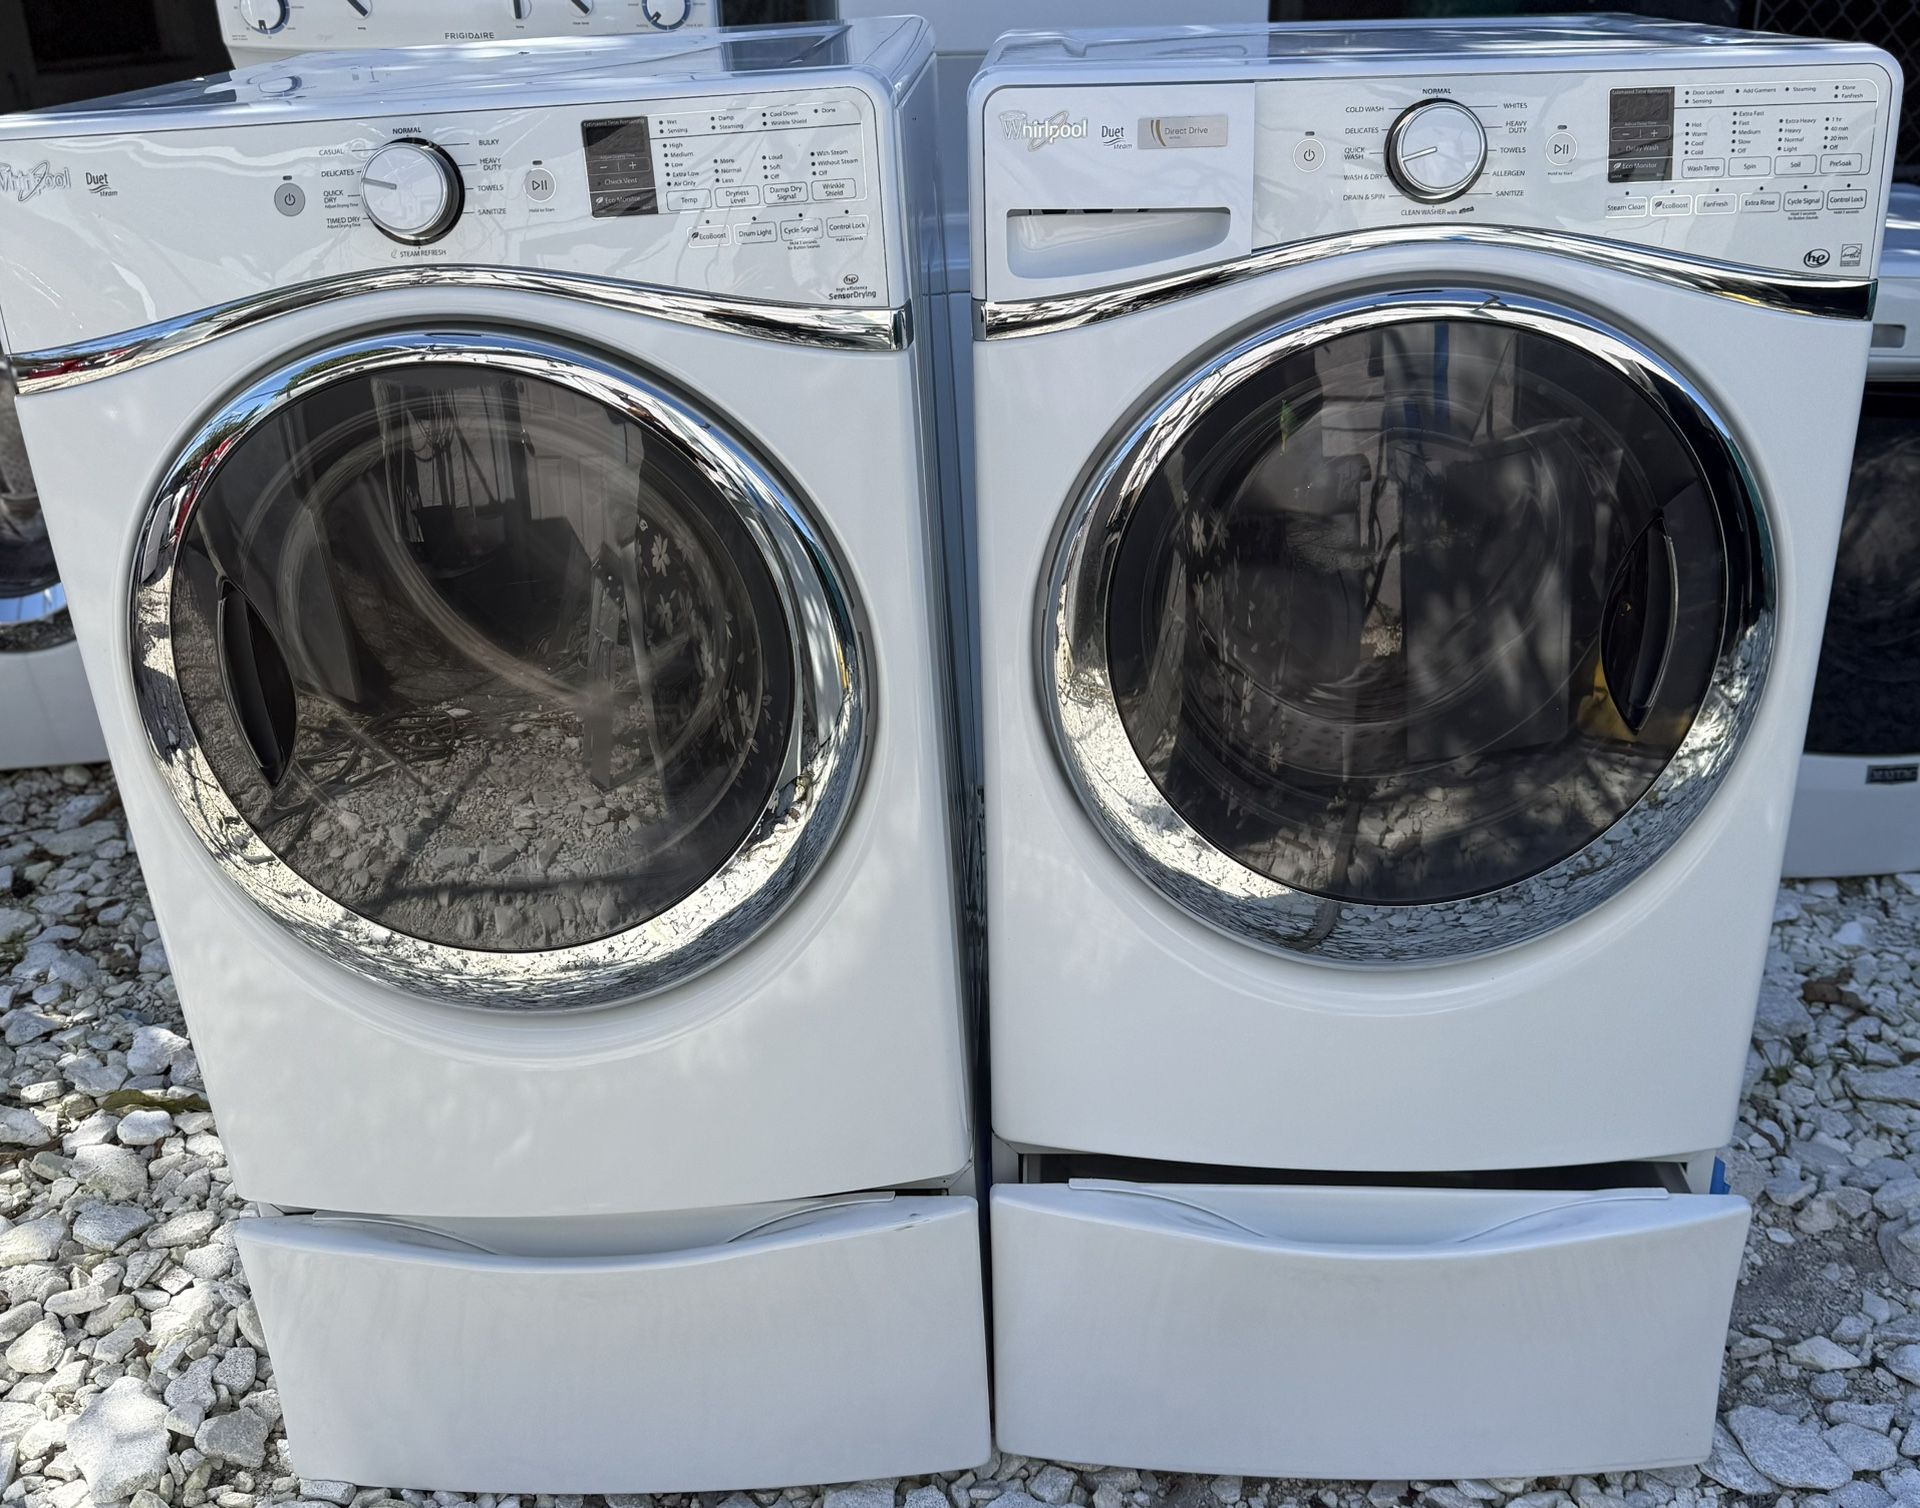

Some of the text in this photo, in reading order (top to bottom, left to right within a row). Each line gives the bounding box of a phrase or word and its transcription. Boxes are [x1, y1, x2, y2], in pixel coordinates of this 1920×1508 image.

[444, 32, 495, 40] FRIGIDAIRE
[392, 126, 422, 135] NORMAL
[998, 113, 1088, 147] Whirlpool
[1101, 125, 1124, 138] Duet
[1164, 126, 1209, 135] Direct Drive
[318, 148, 344, 156] CASUAL
[321, 168, 354, 178] DELICATES
[85, 171, 109, 185] Duet
[323, 189, 344, 197] QUICK
[790, 185, 802, 193] Dry
[825, 189, 844, 197] Shield
[323, 196, 337, 204] DRY
[1803, 197, 1820, 205] Signal
[478, 207, 507, 215] SANITIZE
[783, 227, 800, 235] Cycle
[700, 232, 727, 240] EcoBoost
[400, 250, 420, 258] STEAM
[1806, 251, 1826, 265] he
[828, 291, 877, 300] SensorDrying
